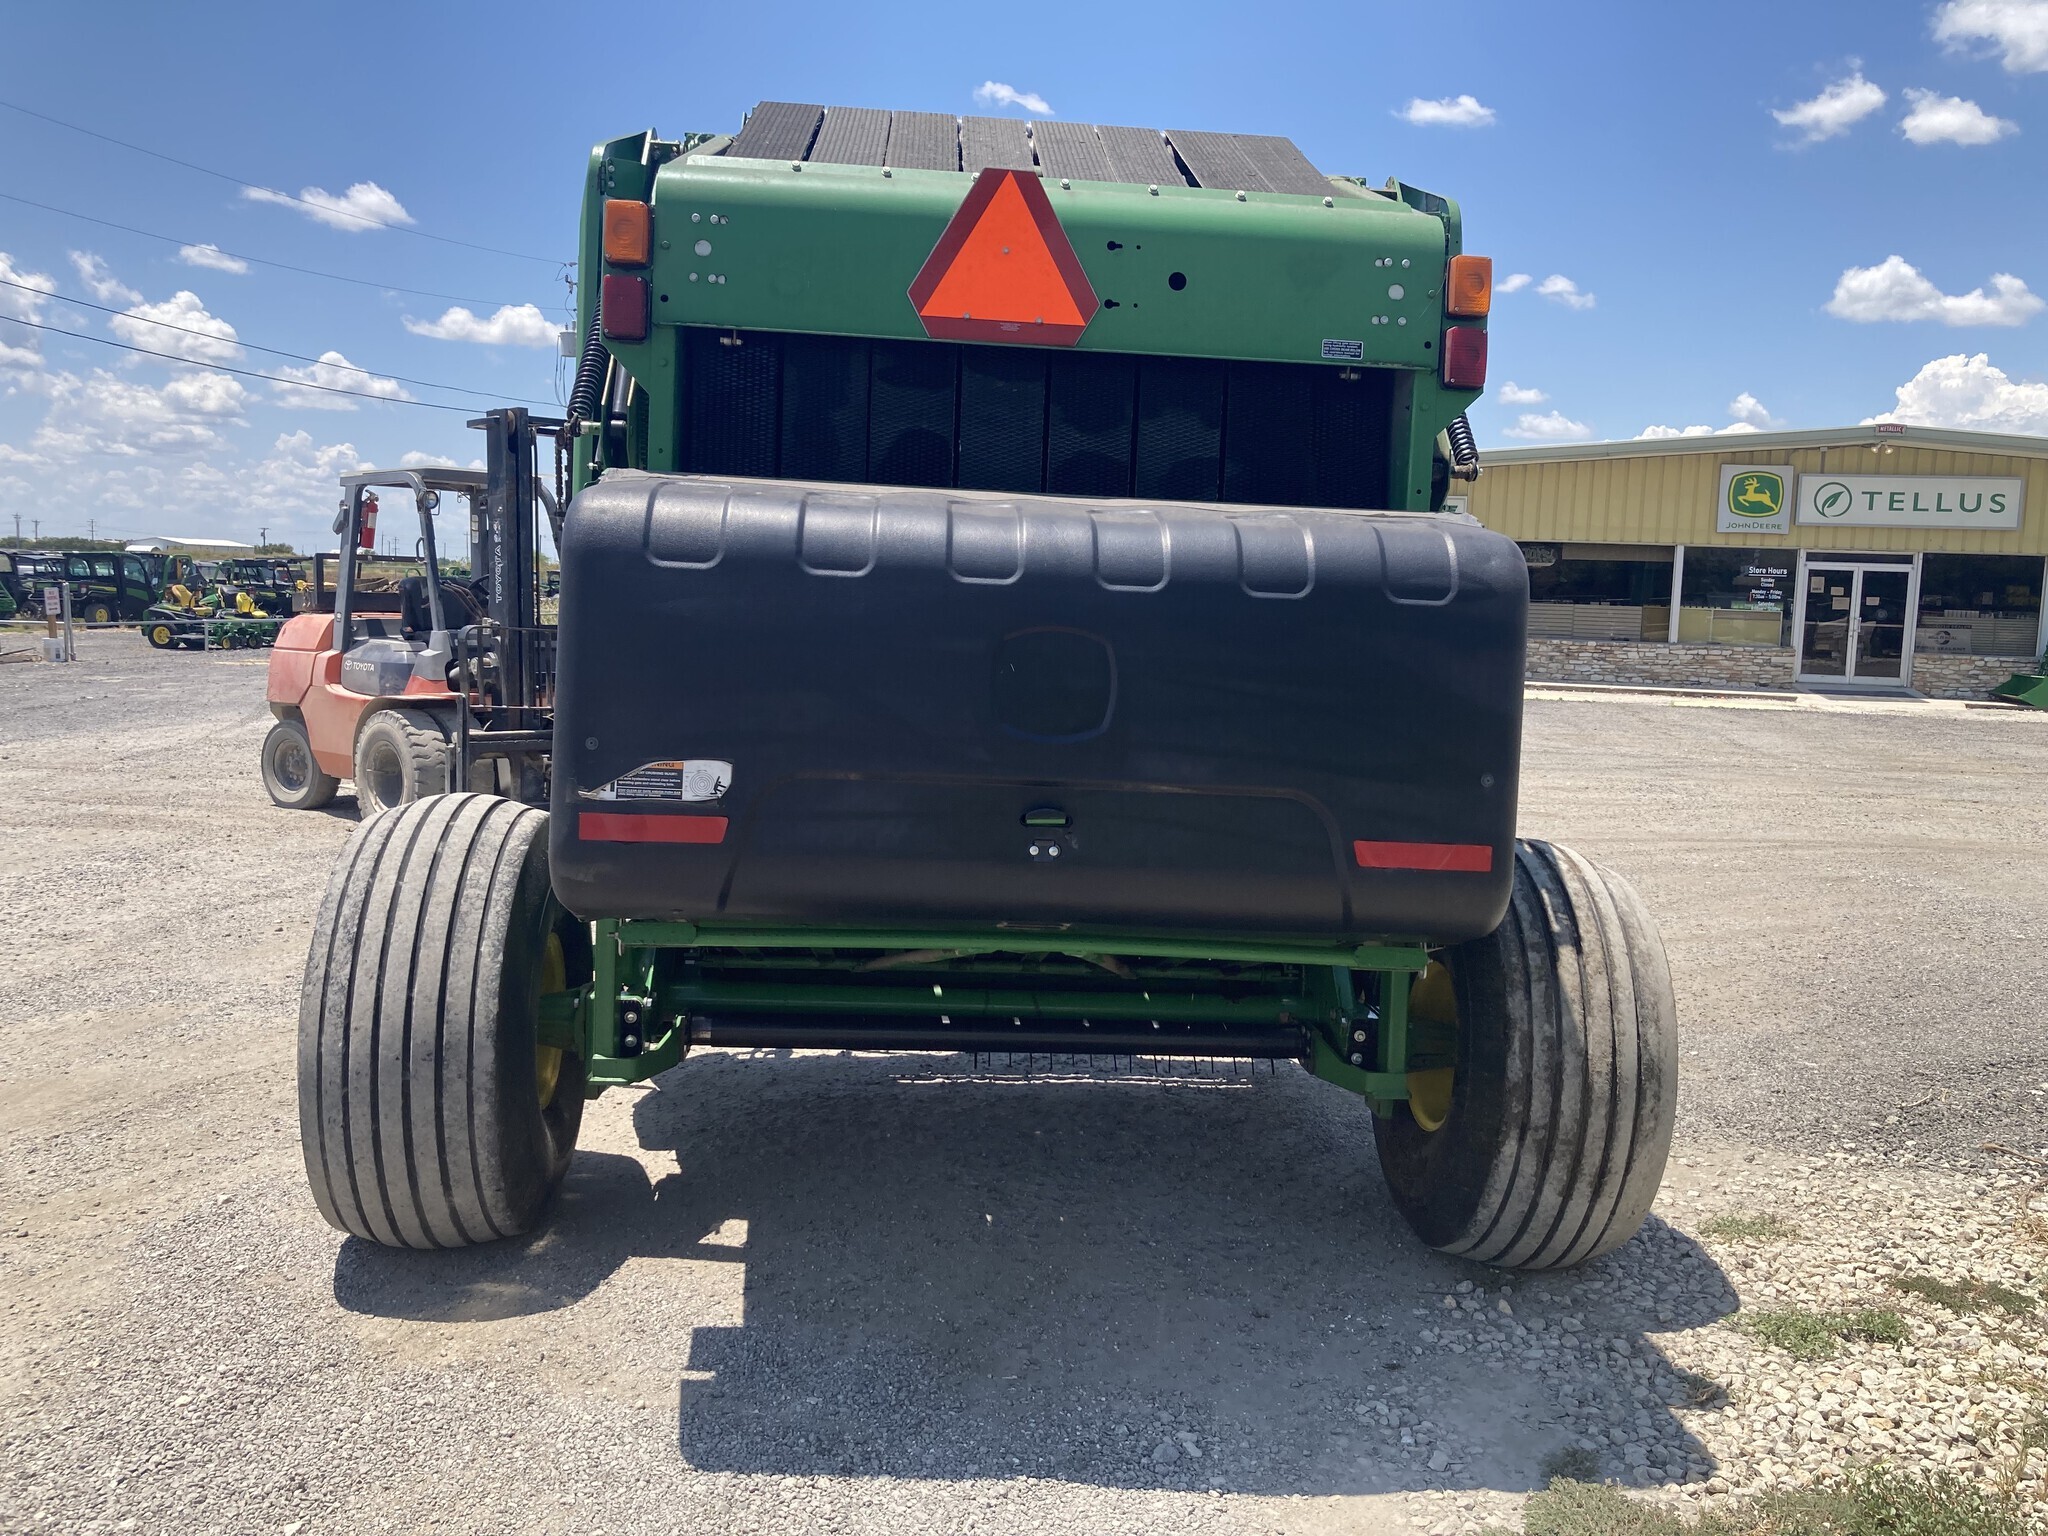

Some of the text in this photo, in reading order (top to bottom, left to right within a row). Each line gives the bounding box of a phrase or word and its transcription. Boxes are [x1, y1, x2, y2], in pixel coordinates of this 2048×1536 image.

[1861, 491, 2006, 513] TELLUS
[1752, 522, 1783, 530] DEERE
[494, 544, 503, 604] TOYOTA
[1749, 566, 1788, 575] Store Hours
[353, 661, 375, 672] TOYOTA
